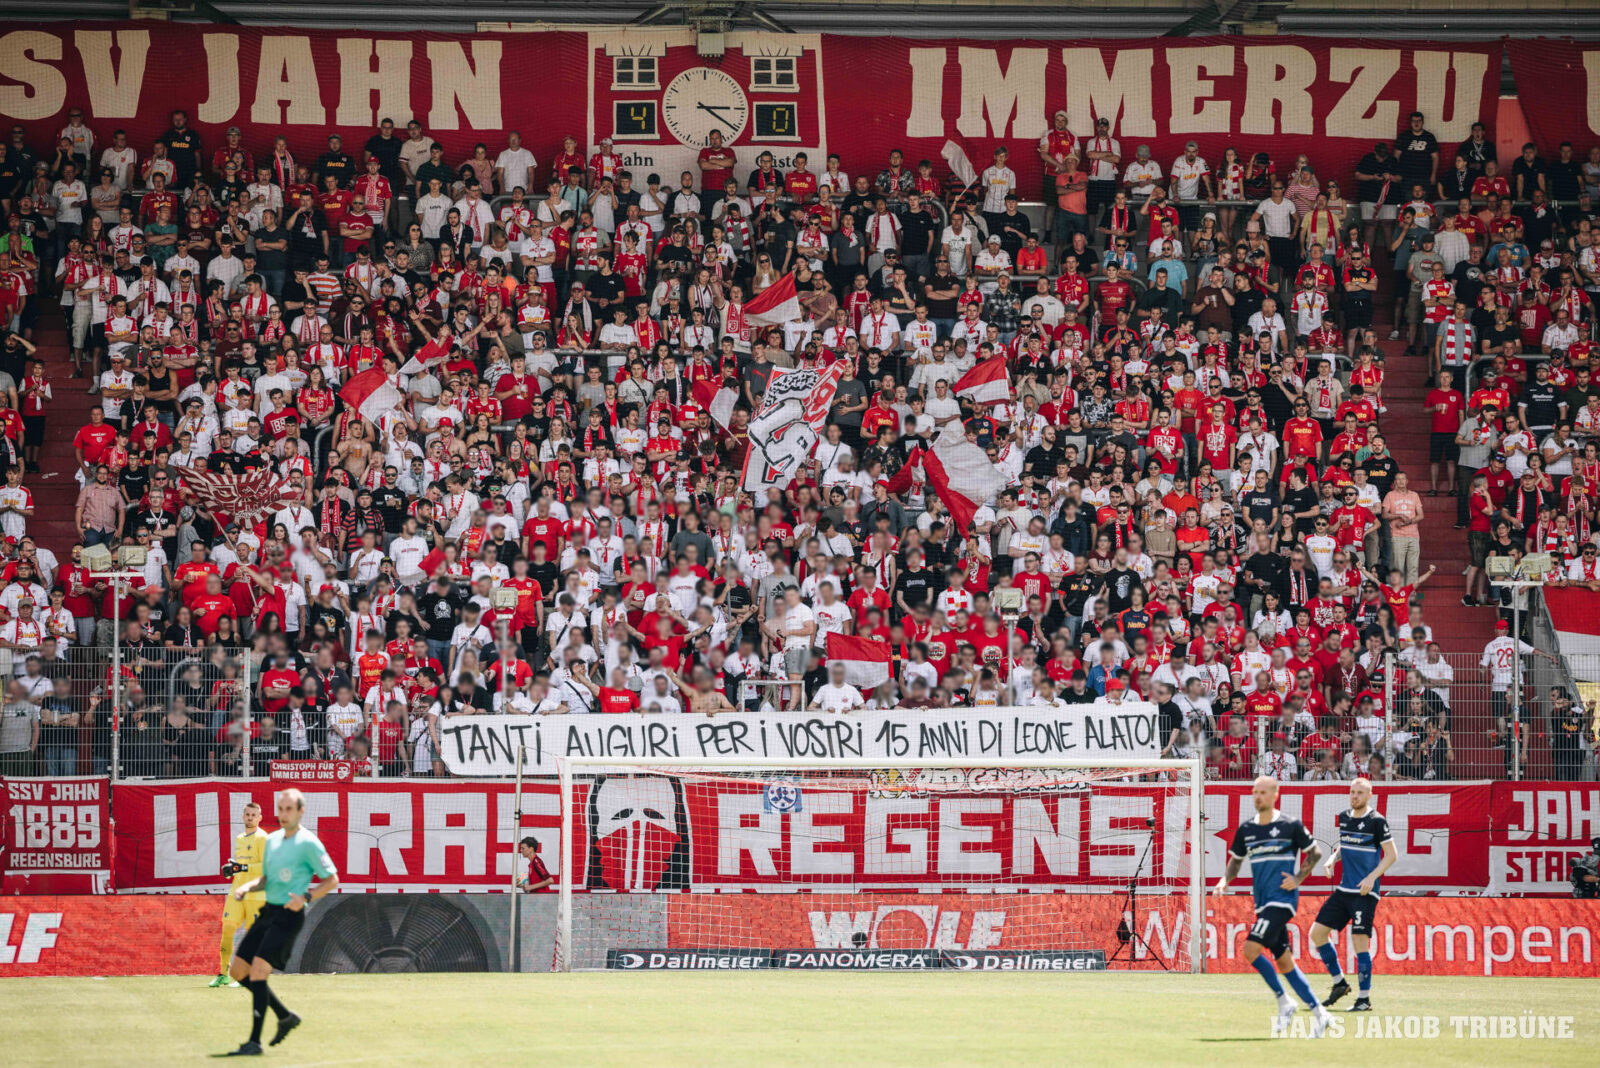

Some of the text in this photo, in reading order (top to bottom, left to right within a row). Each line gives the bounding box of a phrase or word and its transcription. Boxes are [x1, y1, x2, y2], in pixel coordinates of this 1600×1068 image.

[0, 29, 503, 130] SV JAHN
[906, 45, 1488, 143] IMMERZU
[631, 106, 647, 130] 4
[772, 107, 789, 132] 0
[1482, 398, 1500, 407] Netto
[1293, 426, 1312, 435] Netto
[1370, 469, 1387, 477] Netto
[1127, 621, 1146, 630] Netto
[1254, 704, 1273, 712] Netto
[696, 720, 754, 756] PER
[875, 719, 910, 758] 15
[1013, 716, 1077, 755] LEONE
[1084, 713, 1158, 751] ALATO!
[271, 761, 335, 772] CHRISTOPH FÜR
[271, 770, 335, 780] IMMER BEI UNS
[8, 782, 100, 801] SSV JAHN
[9, 804, 101, 848] 1889
[10, 852, 101, 868] REGENSBURG
[1254, 917, 1270, 936] 11
[1354, 910, 1362, 925] 3
[808, 905, 1007, 949] WOLF
[648, 953, 764, 970] Dallmeier
[982, 954, 1097, 971] Dallmeier
